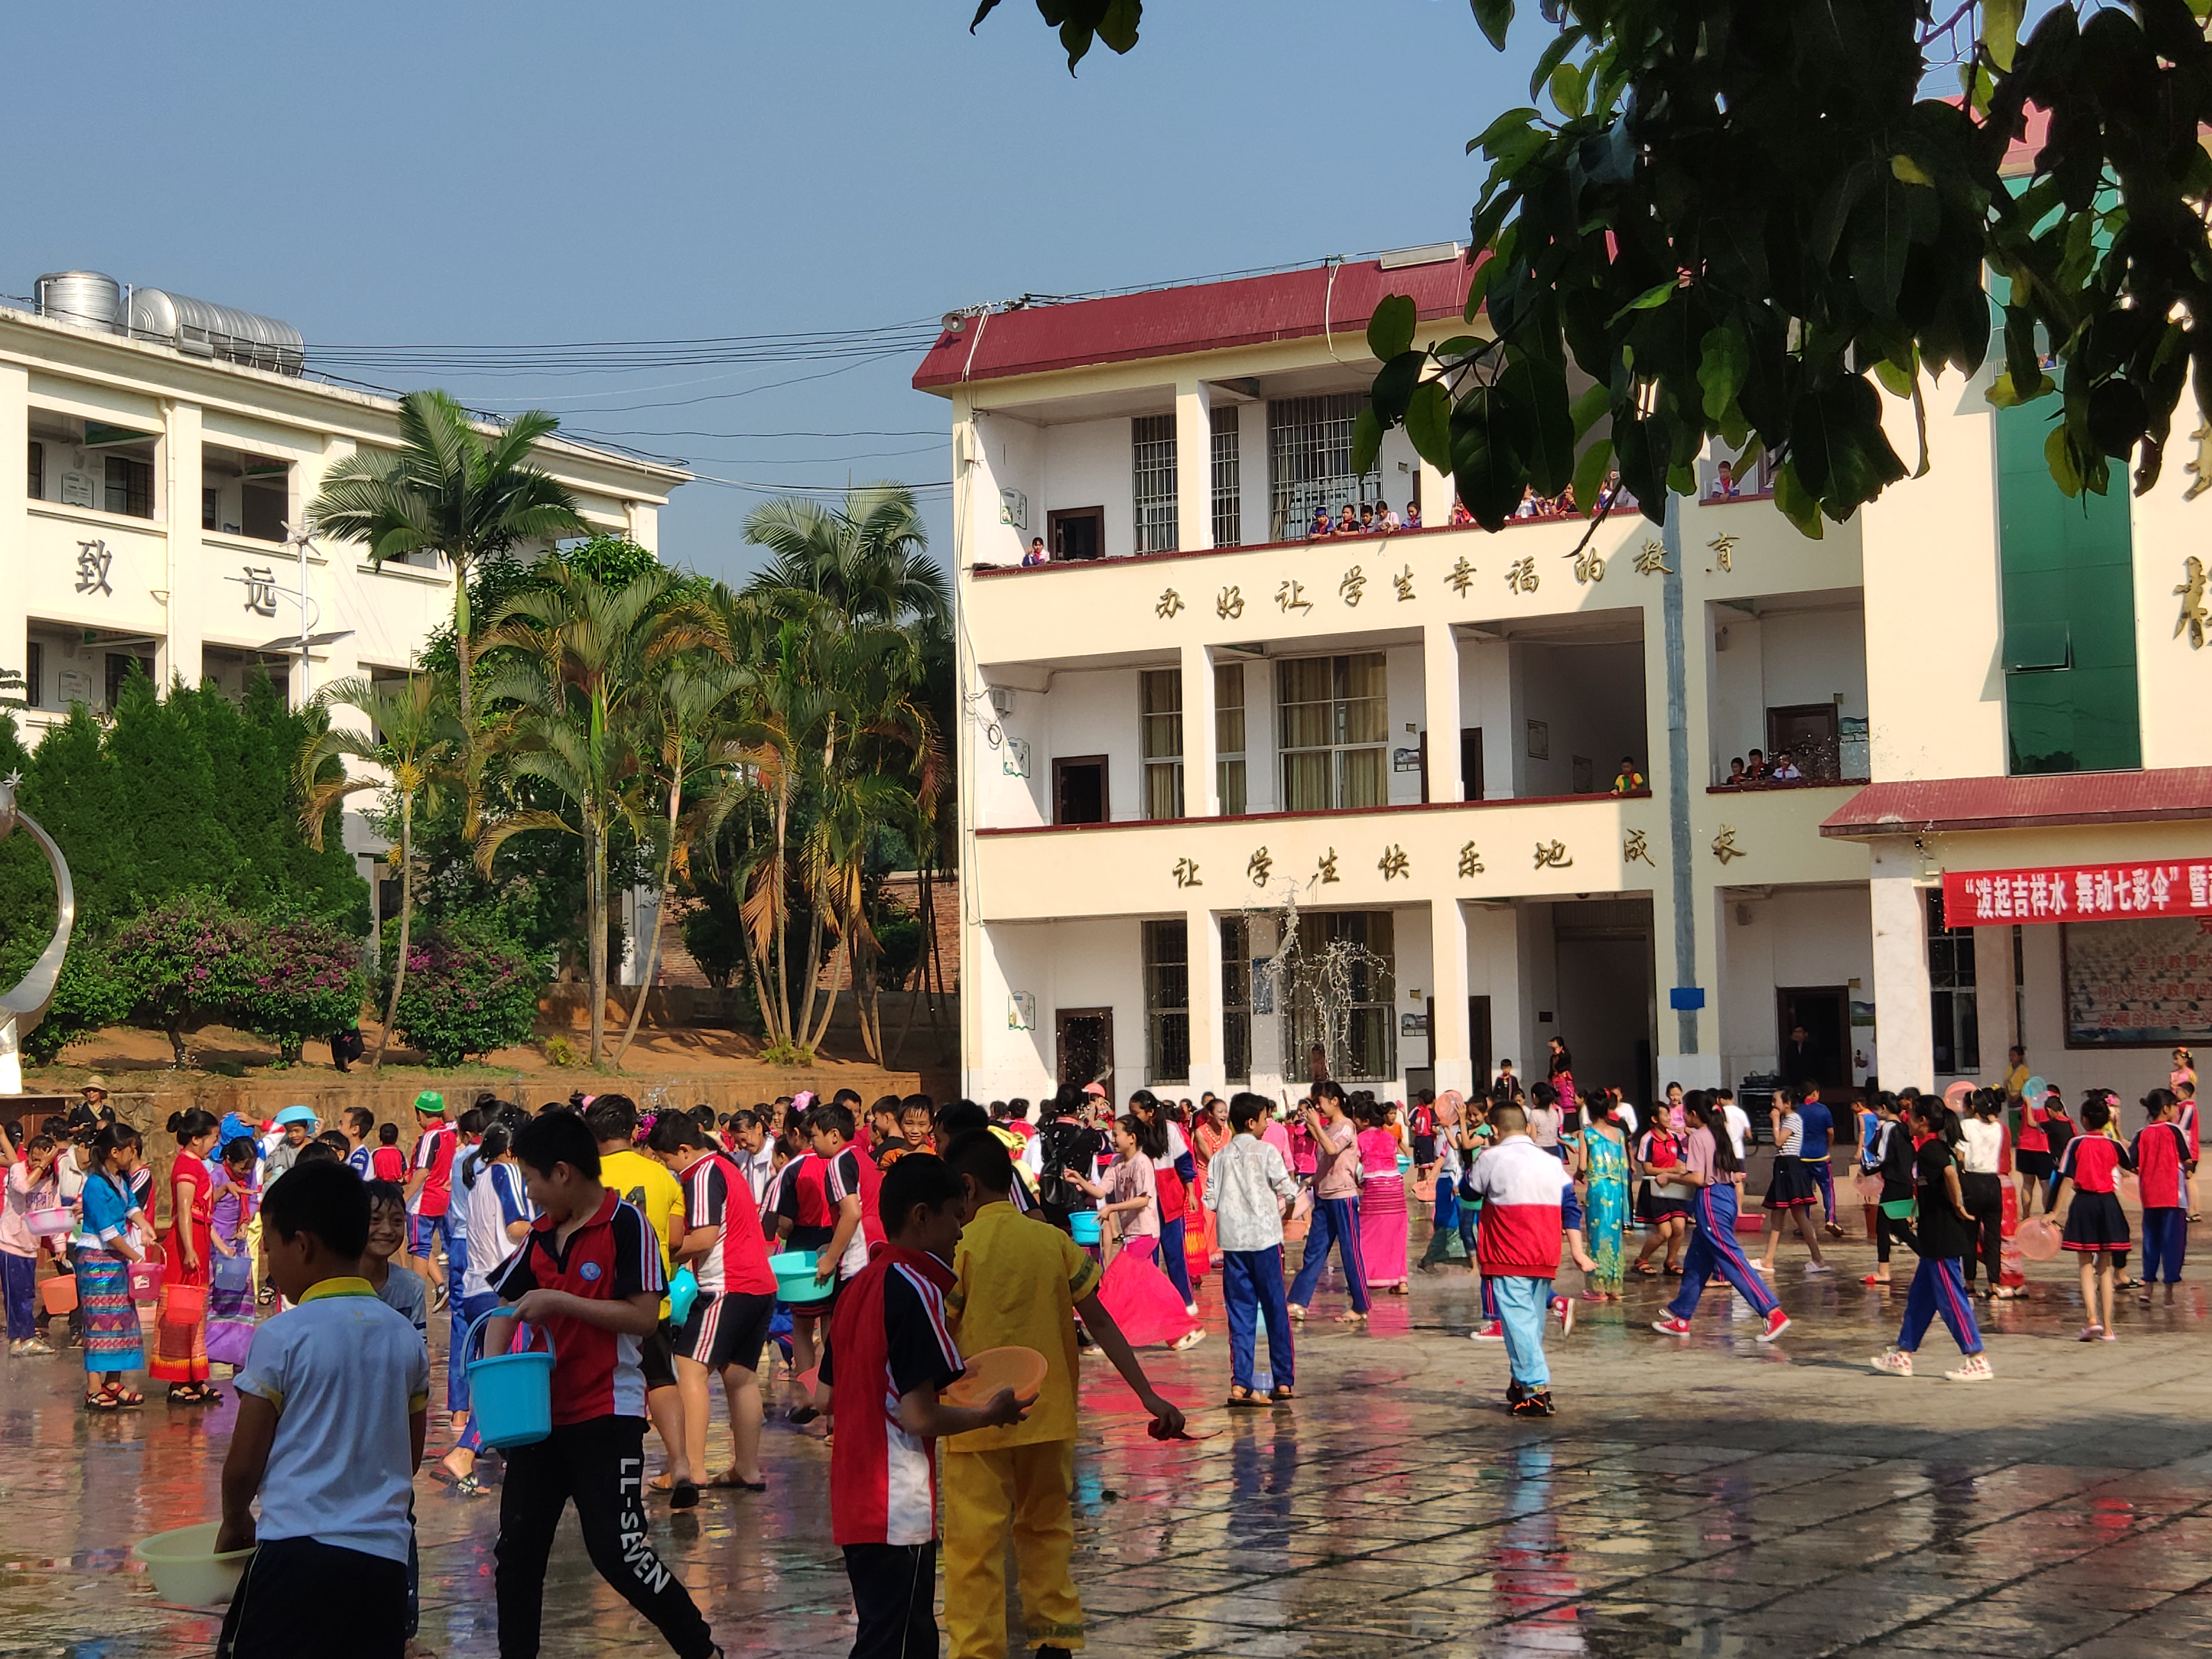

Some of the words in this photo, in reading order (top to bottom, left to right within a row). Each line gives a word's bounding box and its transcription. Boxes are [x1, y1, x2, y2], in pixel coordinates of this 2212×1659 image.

[75, 539, 112, 597] 致
[242, 567, 276, 618] 远
[1155, 532, 1740, 619] 办好让学生幸福的教育
[1172, 825, 1747, 889] 让学生快乐地成长
[2188, 865, 2212, 907] 暨
